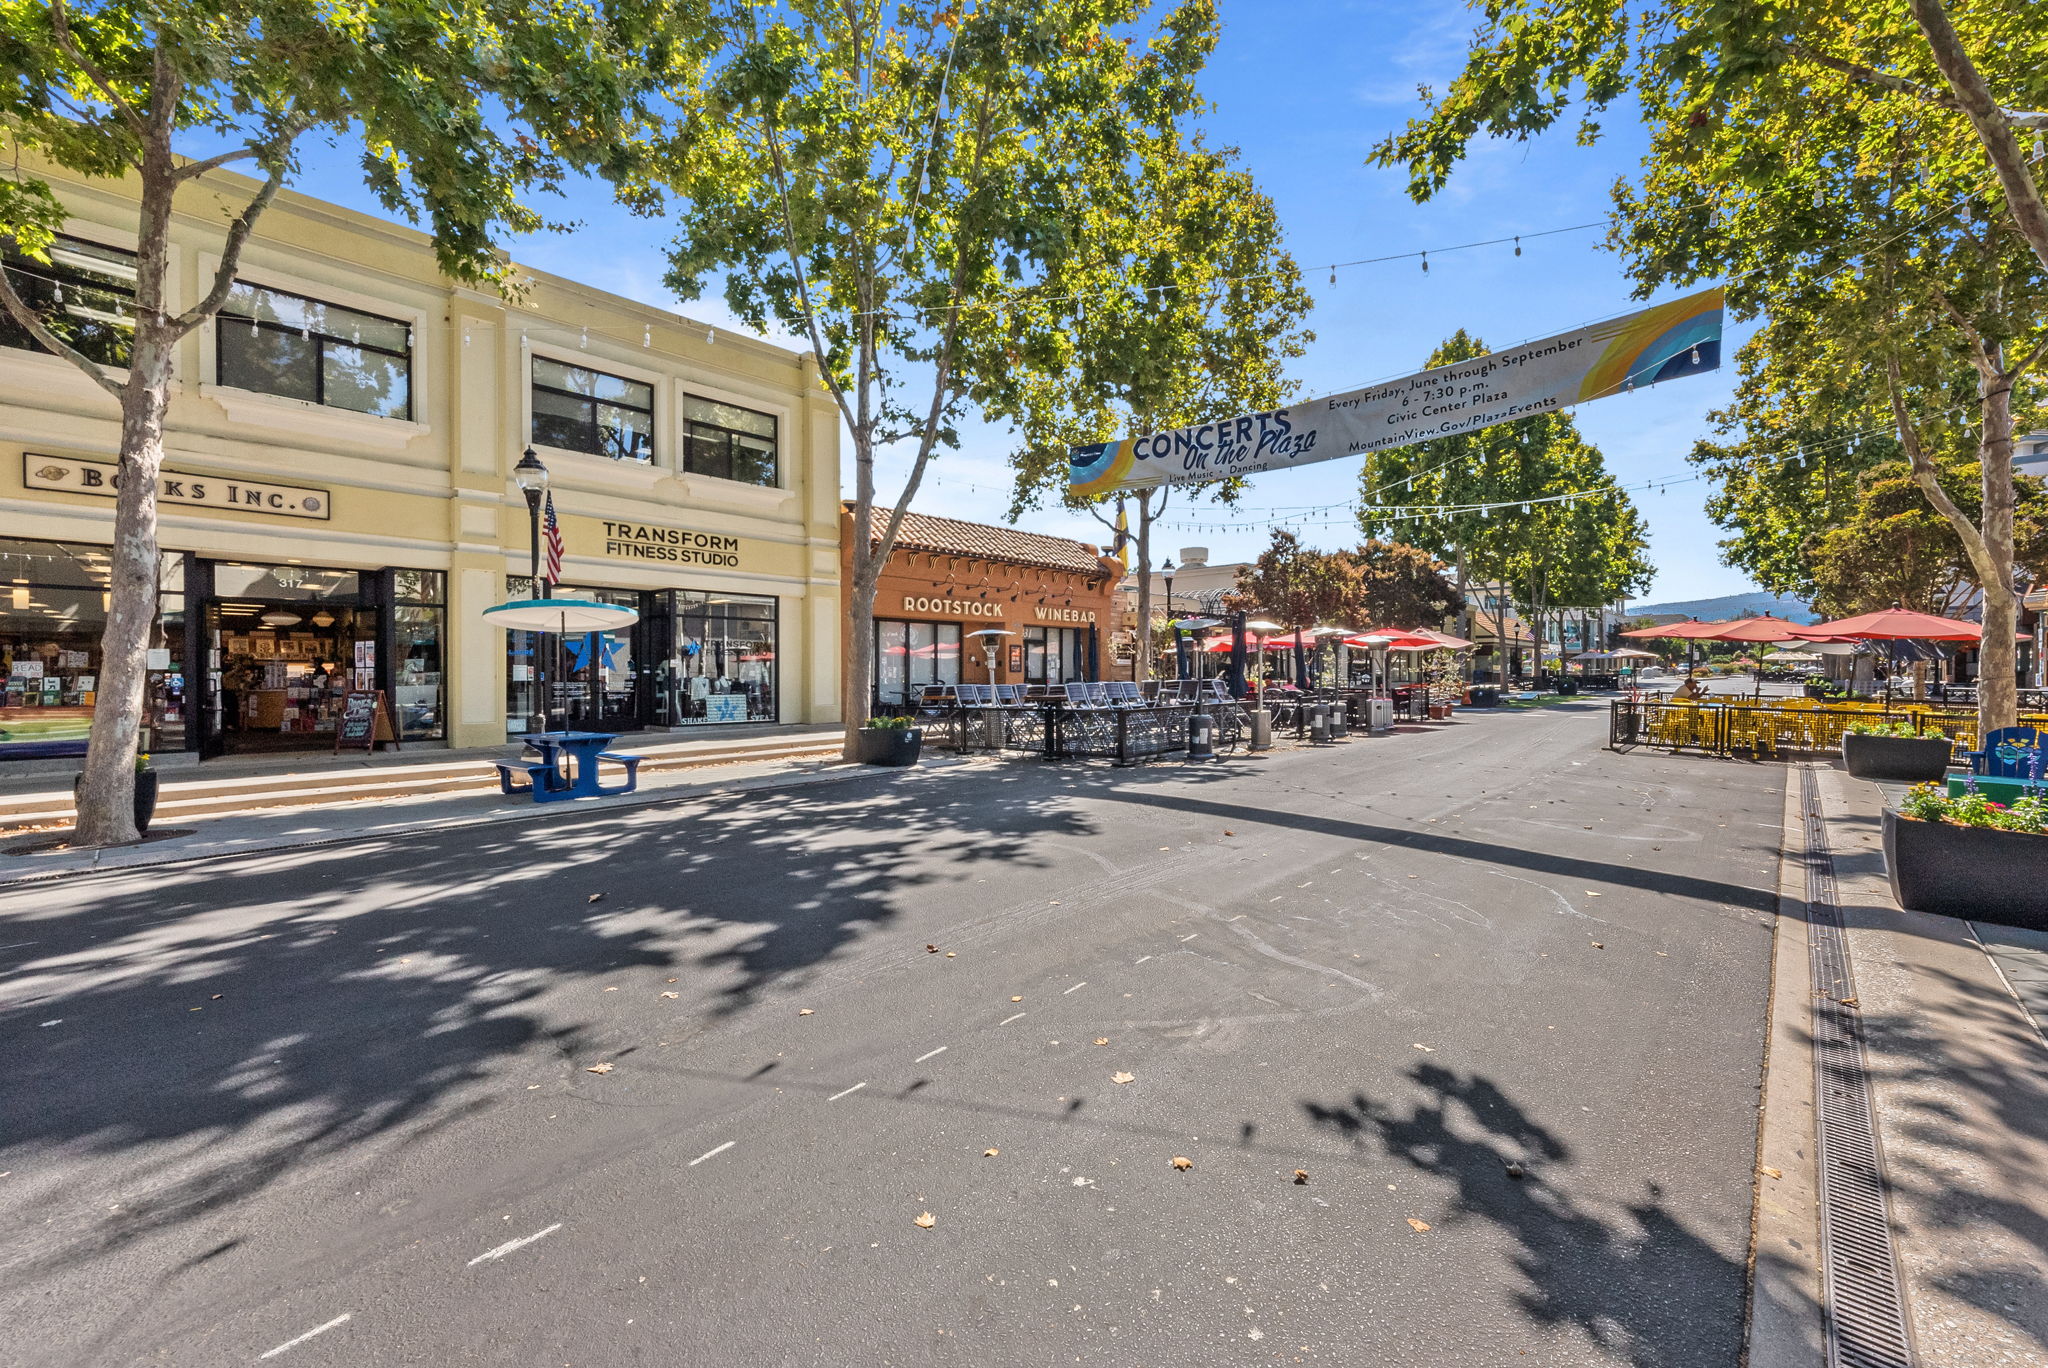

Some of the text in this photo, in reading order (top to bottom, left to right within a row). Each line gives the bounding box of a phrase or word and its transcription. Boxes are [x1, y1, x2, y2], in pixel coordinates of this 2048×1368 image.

[1328, 338, 1583, 411] Every Friday, June through September
[1387, 391, 1508, 426] Civic Center Plaza
[1401, 395, 1410, 407] 6
[1423, 386, 1454, 402] 7:30
[1459, 382, 1489, 399] p.m.
[1133, 409, 1293, 461] CONCERTS
[1348, 396, 1558, 453] MountainView.Gov/PlazaEvents
[1182, 429, 1318, 471] On the Plaza
[81, 467, 206, 500] BKS
[1169, 461, 1269, 483] Live Music Dancing
[602, 521, 739, 552] TRANSFORM
[606, 541, 739, 567] FITNESS STUDIO
[278, 578, 304, 589] 317
[903, 596, 1096, 623] ROOTSTOCK WINEBAR
[12, 664, 43, 672] READ
